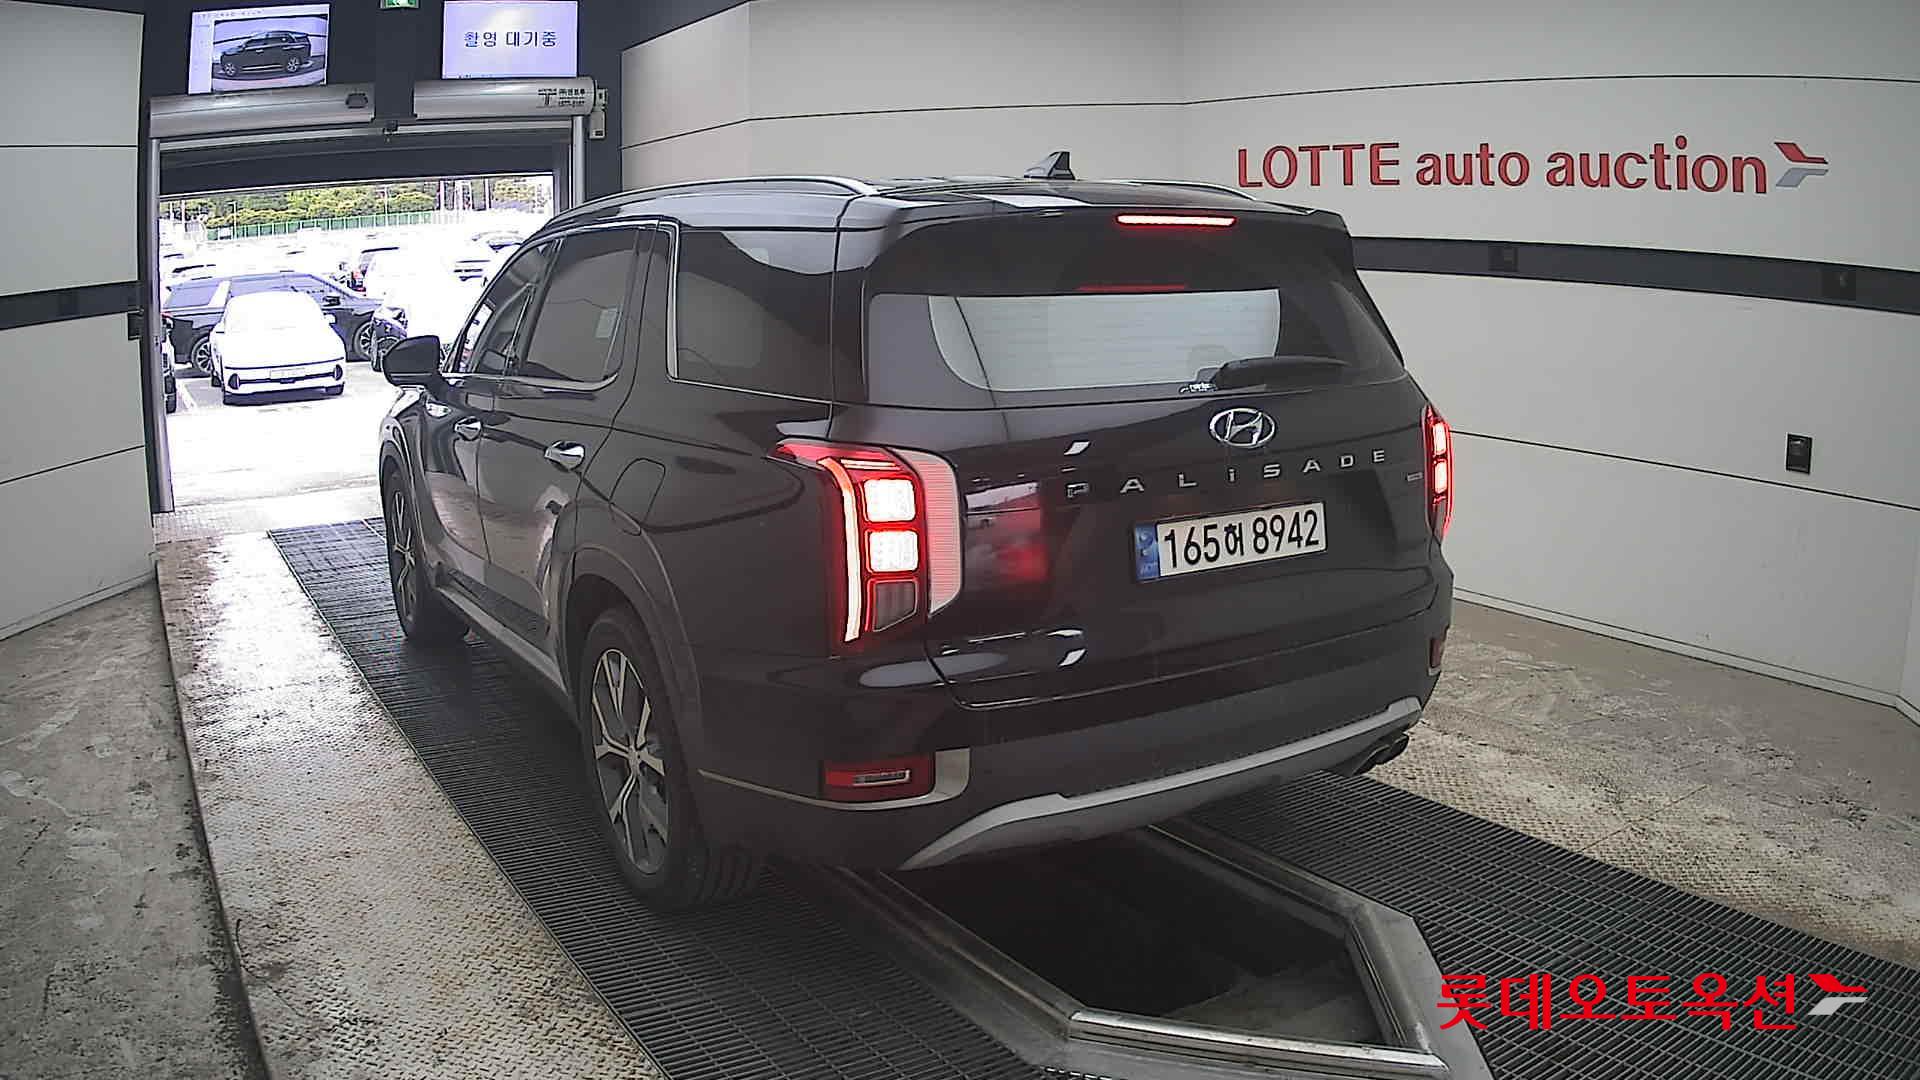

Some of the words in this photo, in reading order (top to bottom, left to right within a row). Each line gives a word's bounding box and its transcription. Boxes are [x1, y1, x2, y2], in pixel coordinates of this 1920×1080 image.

[505, 31, 556, 47] 대기중
[1237, 142, 1400, 188] LOTTE
[1415, 142, 1530, 189] auto
[1546, 135, 1767, 194] auction
[1164, 522, 1244, 569] 165허
[1252, 509, 1320, 554] 8942
